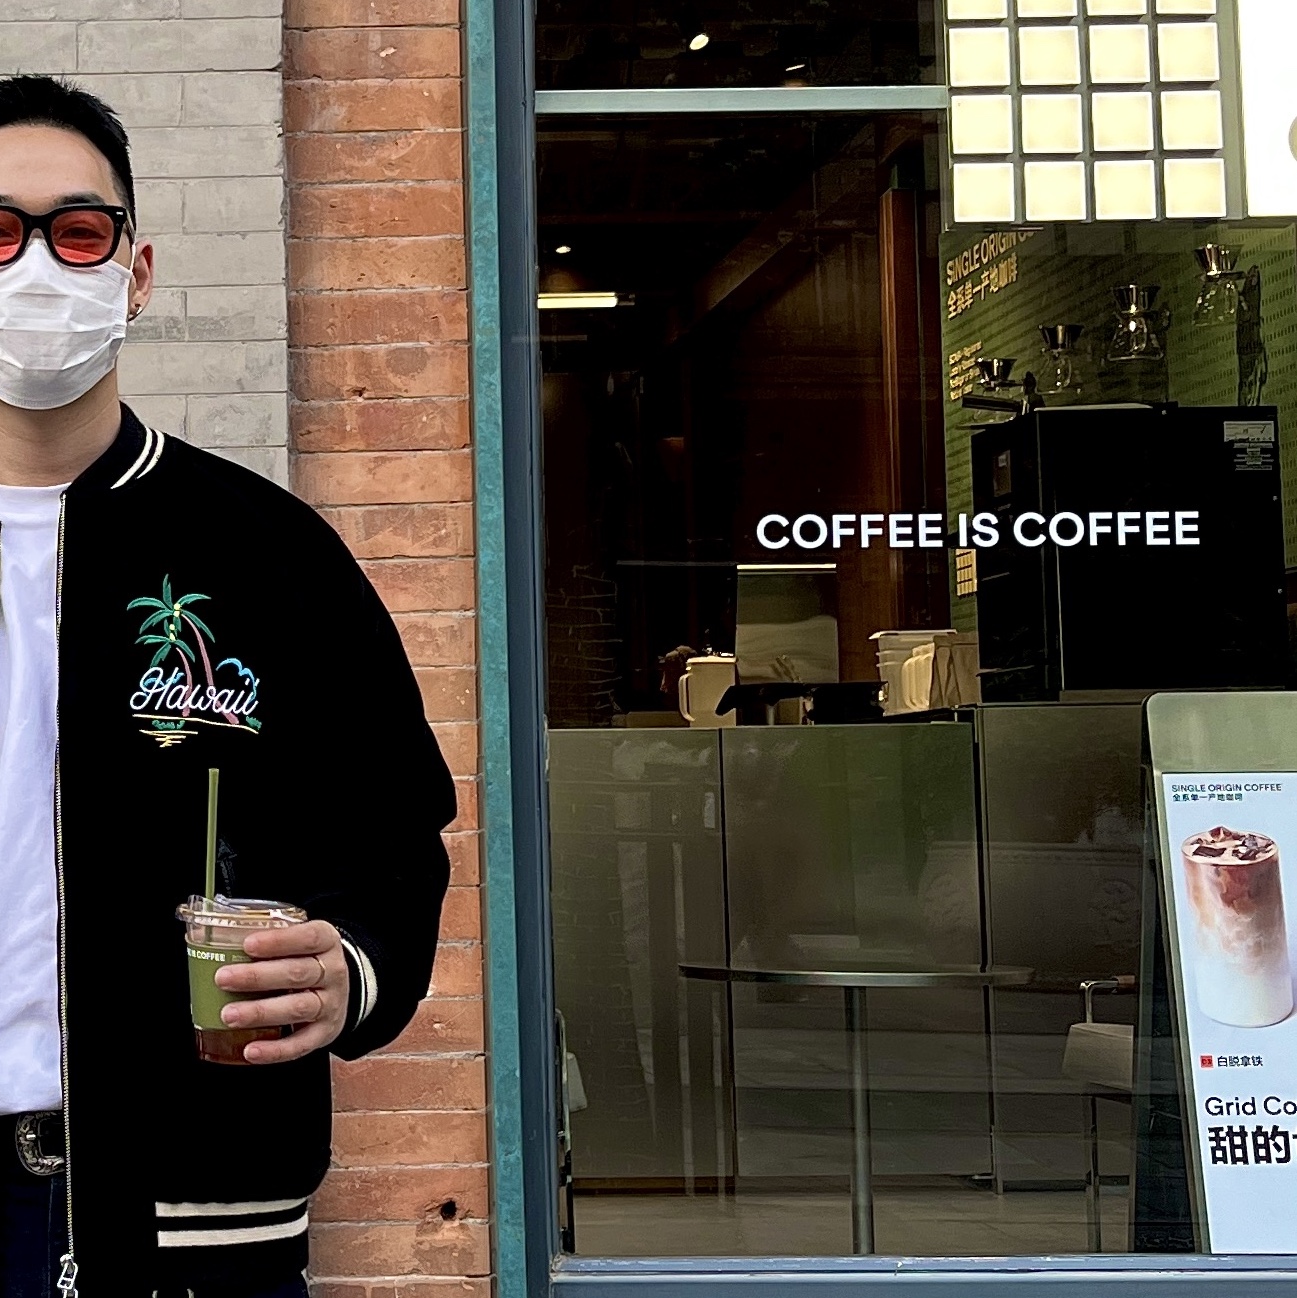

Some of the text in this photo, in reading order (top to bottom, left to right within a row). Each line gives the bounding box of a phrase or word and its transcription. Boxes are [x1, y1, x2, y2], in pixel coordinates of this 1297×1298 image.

[946, 243, 981, 286] SINGLE
[755, 510, 1201, 550] COFFEE IS COFFEE
[129, 666, 260, 716] Hawaii
[1171, 783, 1282, 792] SINGLE ORIGIN COFFEE
[196, 950, 225, 961] COFFEE
[1217, 1055, 1264, 1068] 白脱拿铁
[1204, 1096, 1297, 1117] Grid Co
[1207, 1124, 1297, 1165] 甜的
